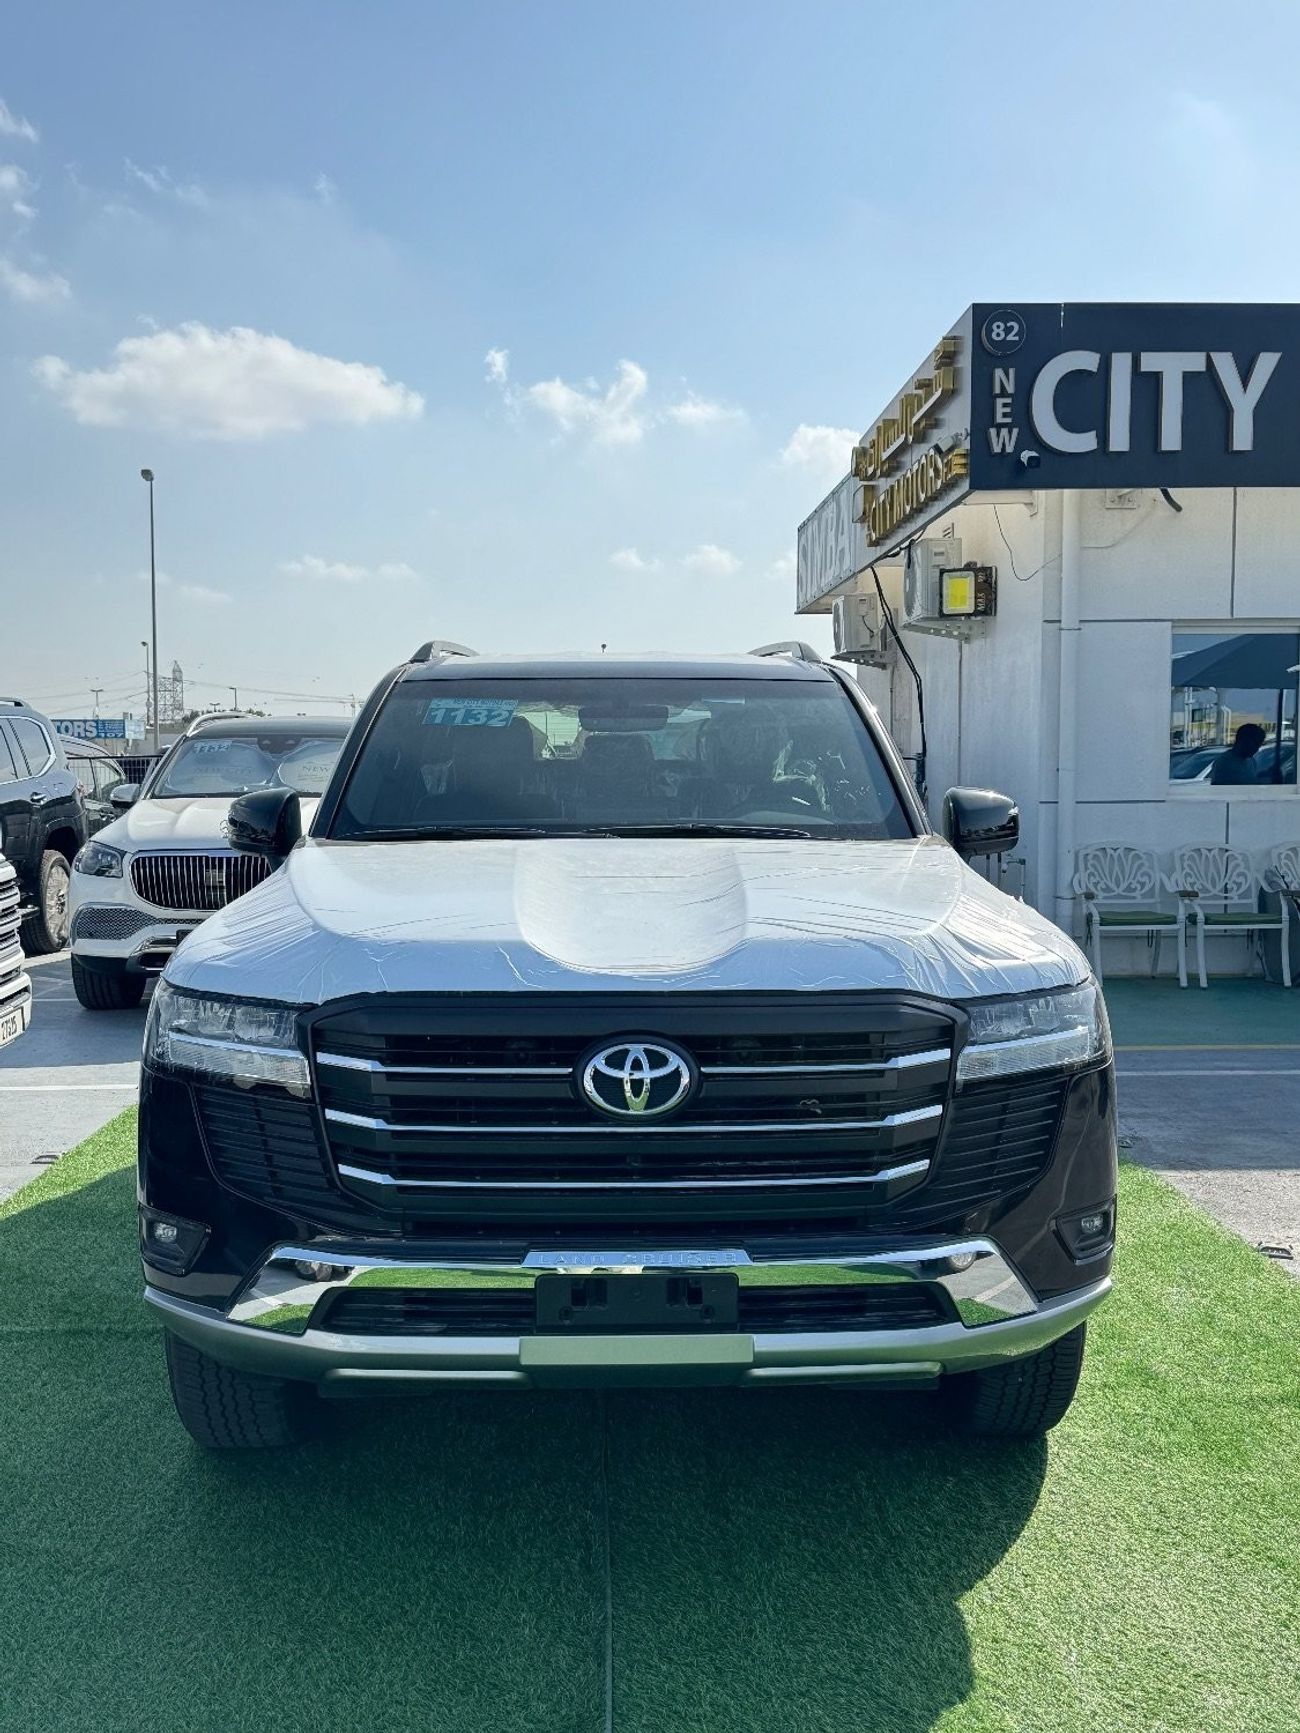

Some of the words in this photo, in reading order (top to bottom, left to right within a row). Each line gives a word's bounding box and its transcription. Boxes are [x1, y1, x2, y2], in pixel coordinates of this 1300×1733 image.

[990, 322, 1019, 342] 82
[988, 367, 1021, 455] NEW
[1030, 350, 1283, 454] CITY
[430, 708, 510, 727] 1132
[538, 1253, 606, 1265] LAND
[623, 1252, 738, 1264] CRUISER
